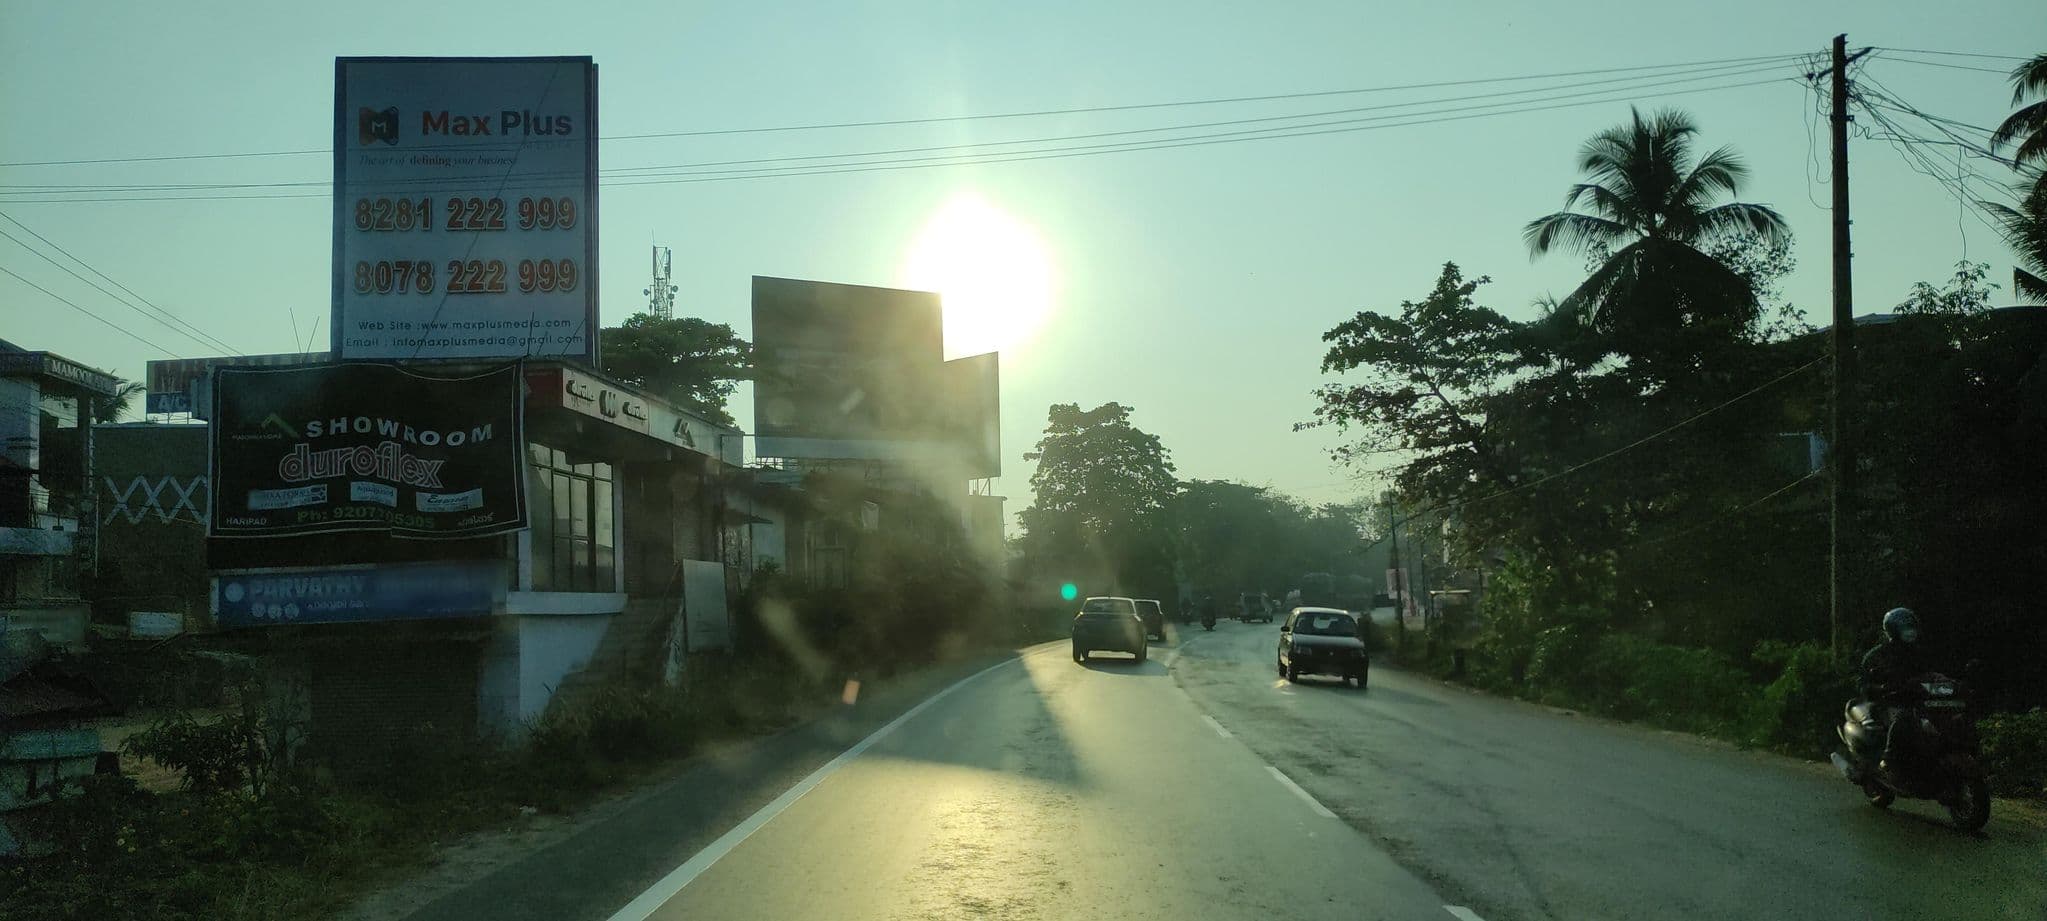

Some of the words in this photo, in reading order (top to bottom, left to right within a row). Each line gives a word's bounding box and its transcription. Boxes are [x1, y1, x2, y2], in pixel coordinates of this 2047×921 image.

[423, 111, 490, 135] Max
[501, 110, 572, 136] Plus
[409, 154, 451, 168] defining
[477, 154, 516, 167] busines
[355, 197, 433, 231] 8281
[445, 197, 506, 231] 222
[518, 197, 577, 231] 999
[354, 260, 435, 294] 8078
[445, 259, 507, 293] 222
[518, 258, 577, 293] 999
[358, 320, 384, 331] Web
[390, 319, 412, 330] Site
[346, 336, 378, 347] Email
[305, 416, 493, 447] SHOWROOM
[279, 441, 445, 488] duroflex
